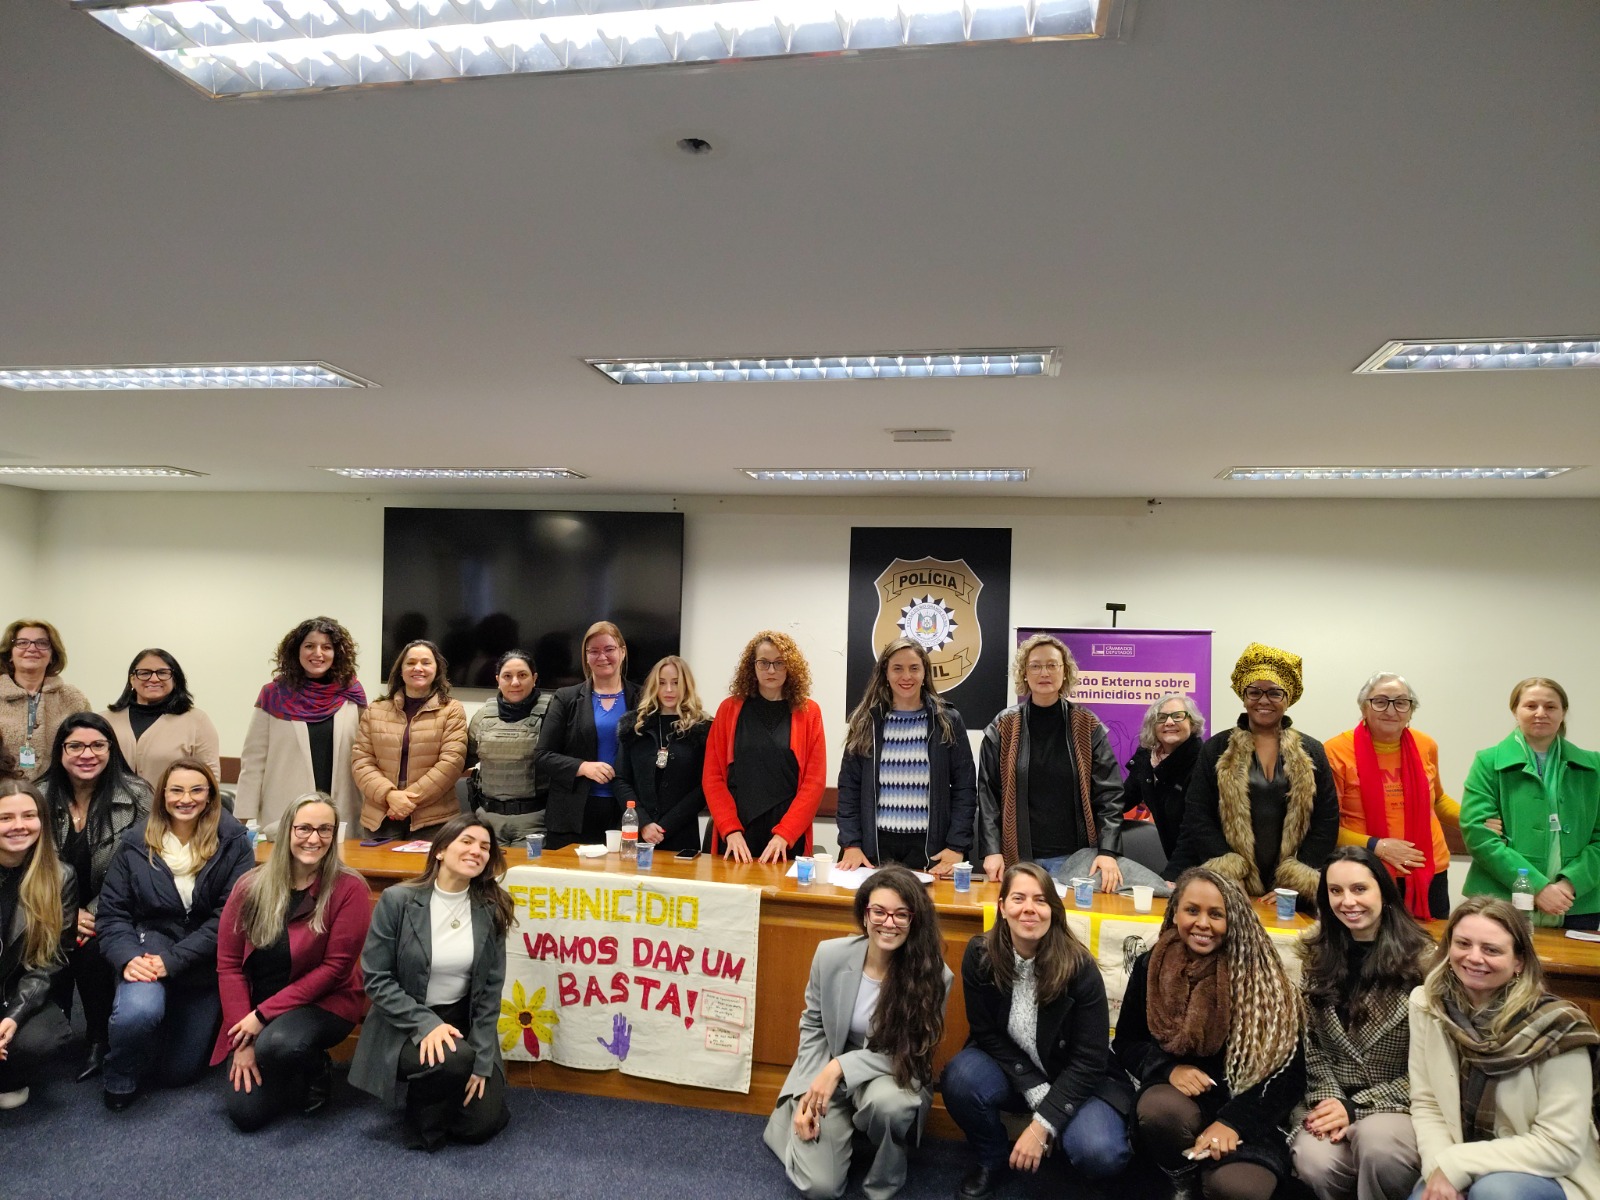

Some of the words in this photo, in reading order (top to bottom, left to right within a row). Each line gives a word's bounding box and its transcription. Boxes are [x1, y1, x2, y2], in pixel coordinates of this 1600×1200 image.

[899, 570, 957, 589] POLÍCIA
[1101, 676, 1152, 687] Externa
[1155, 678, 1190, 688] sobre
[1144, 692, 1161, 700] no
[508, 882, 699, 929] FEMINICÍDIO
[523, 932, 619, 965] VAMOS
[632, 937, 695, 975] DAR
[701, 947, 746, 984] UM
[558, 972, 699, 1030] BASTA!
